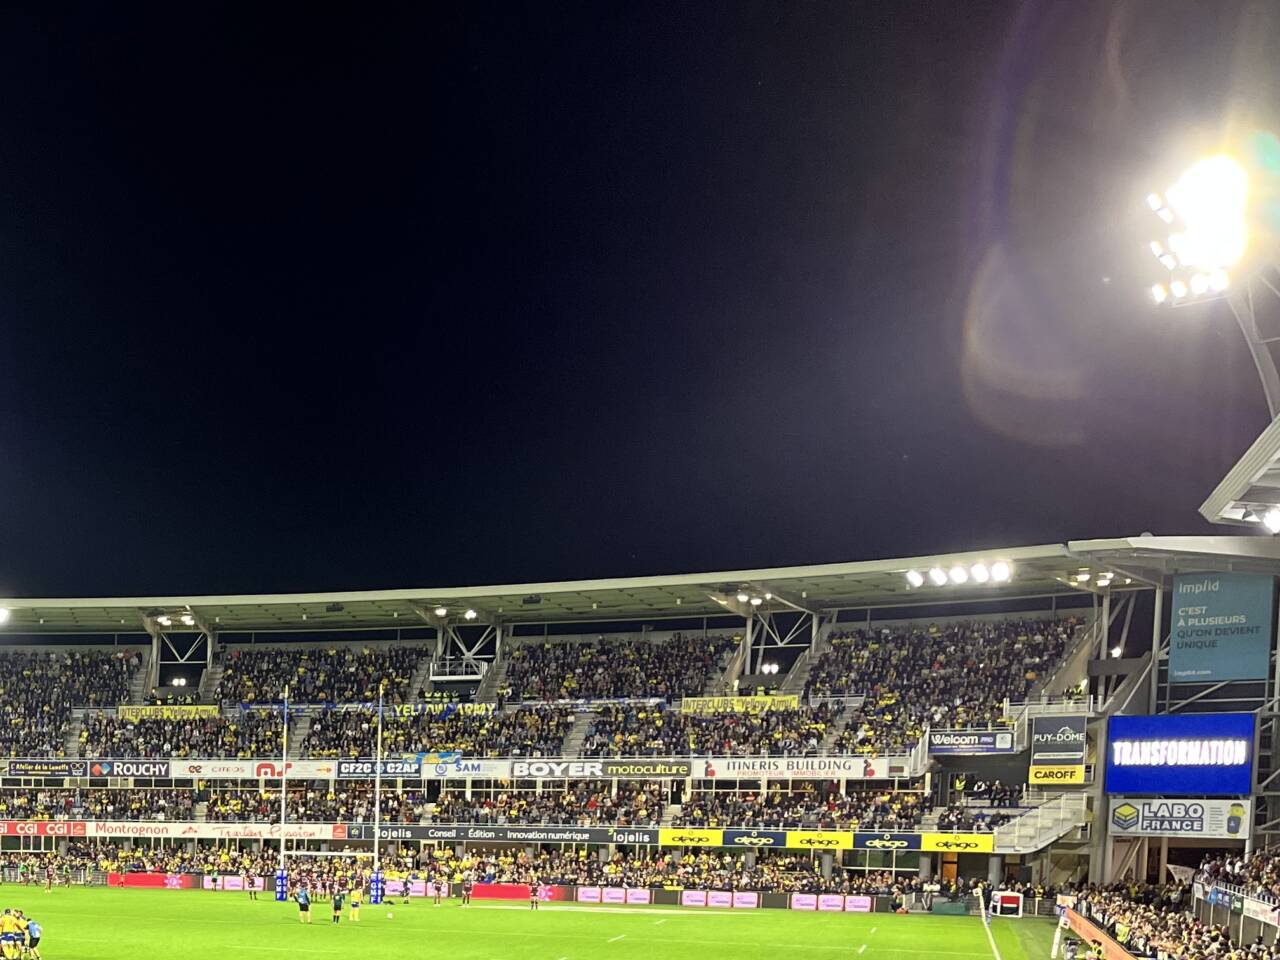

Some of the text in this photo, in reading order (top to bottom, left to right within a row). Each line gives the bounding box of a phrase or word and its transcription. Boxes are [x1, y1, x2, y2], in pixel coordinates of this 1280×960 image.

[1188, 615, 1247, 626] PLUSIEURS
[1214, 625, 1262, 636] DEVIENT
[1176, 640, 1218, 650] UNIQUE
[930, 734, 979, 745] Welcom
[1112, 740, 1248, 766] TRANSFORMATION
[113, 762, 168, 776] ROUCHY
[340, 763, 419, 773] CF2C C2AP
[455, 762, 481, 773] SAM
[512, 762, 688, 777] BOYER motoculture
[726, 760, 852, 772] ITINERIS BUILDING
[1034, 770, 1076, 779] CAROFF
[1142, 803, 1204, 817] LABO
[16, 823, 37, 834] CGI
[46, 824, 67, 834] CGI
[95, 823, 169, 836] Montrognon
[1141, 819, 1204, 831] FRANCE
[428, 827, 590, 841] Conseil Édition Innovation numérique
